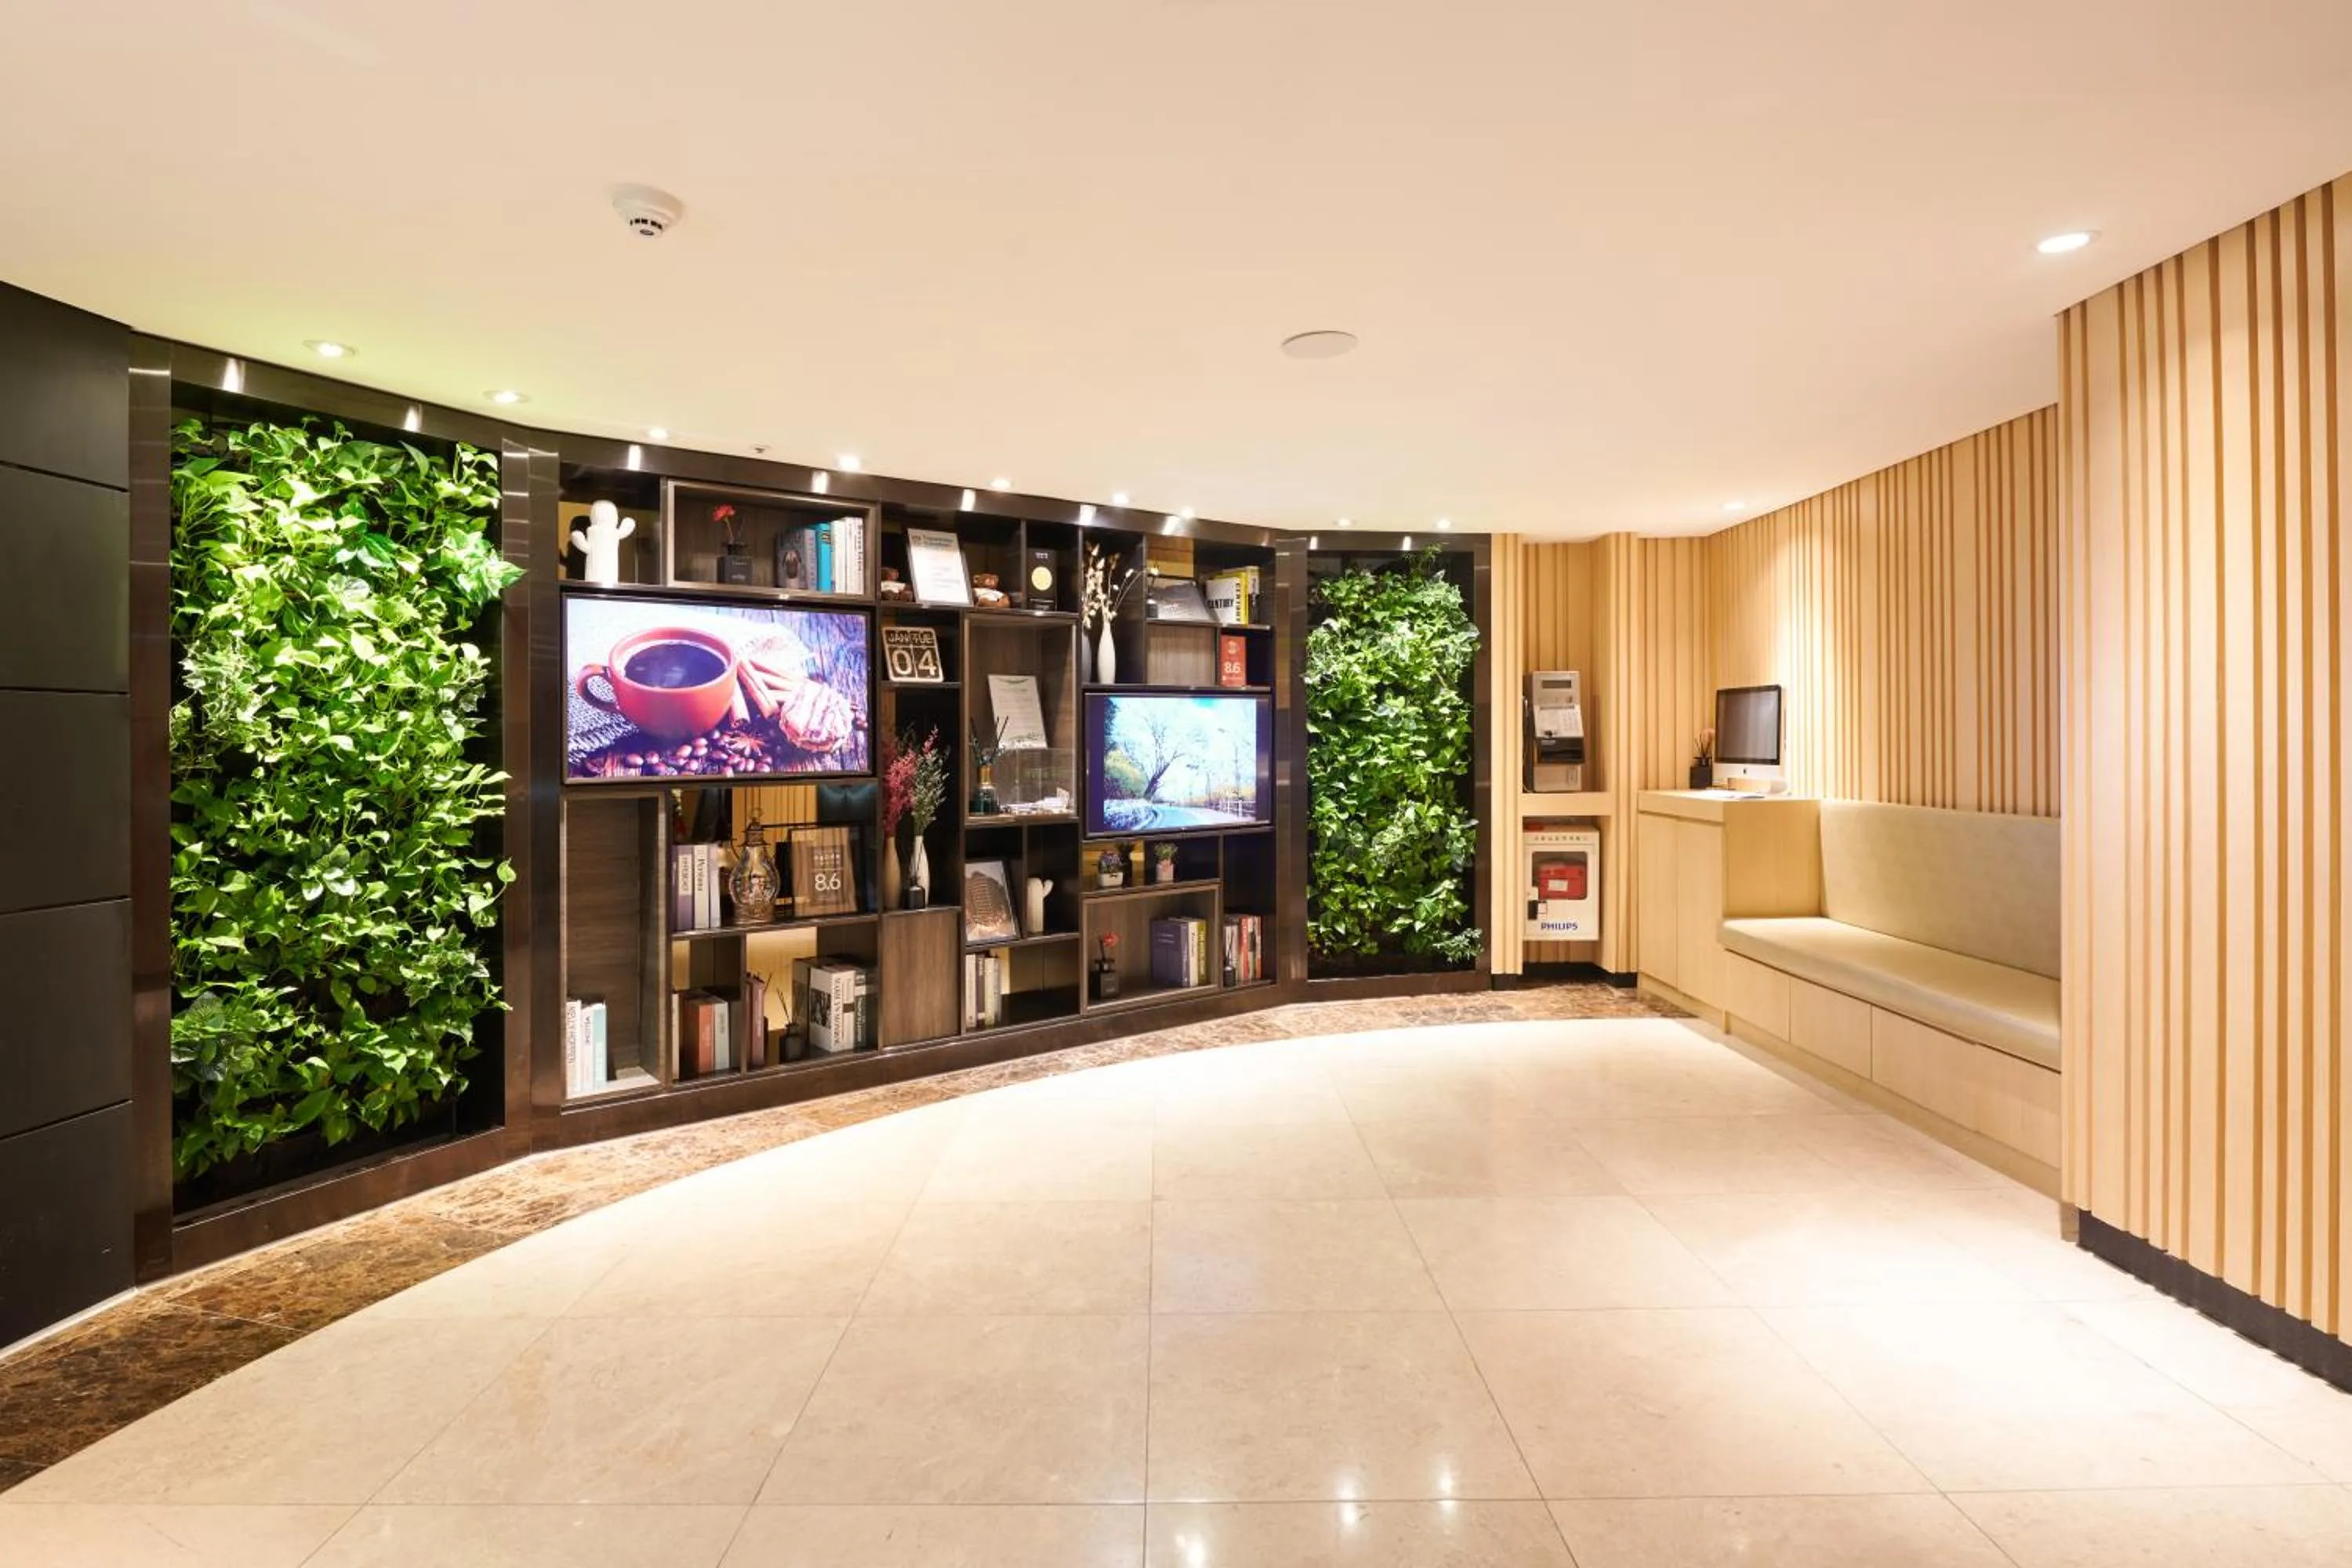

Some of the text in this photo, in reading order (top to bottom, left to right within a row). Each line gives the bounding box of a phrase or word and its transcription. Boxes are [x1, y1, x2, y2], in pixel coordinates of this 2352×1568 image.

[888, 633, 933, 644] JAN TUE
[892, 650, 937, 676] 04
[815, 873, 841, 891] 8.6
[1541, 922, 1578, 931] PHILIPS
